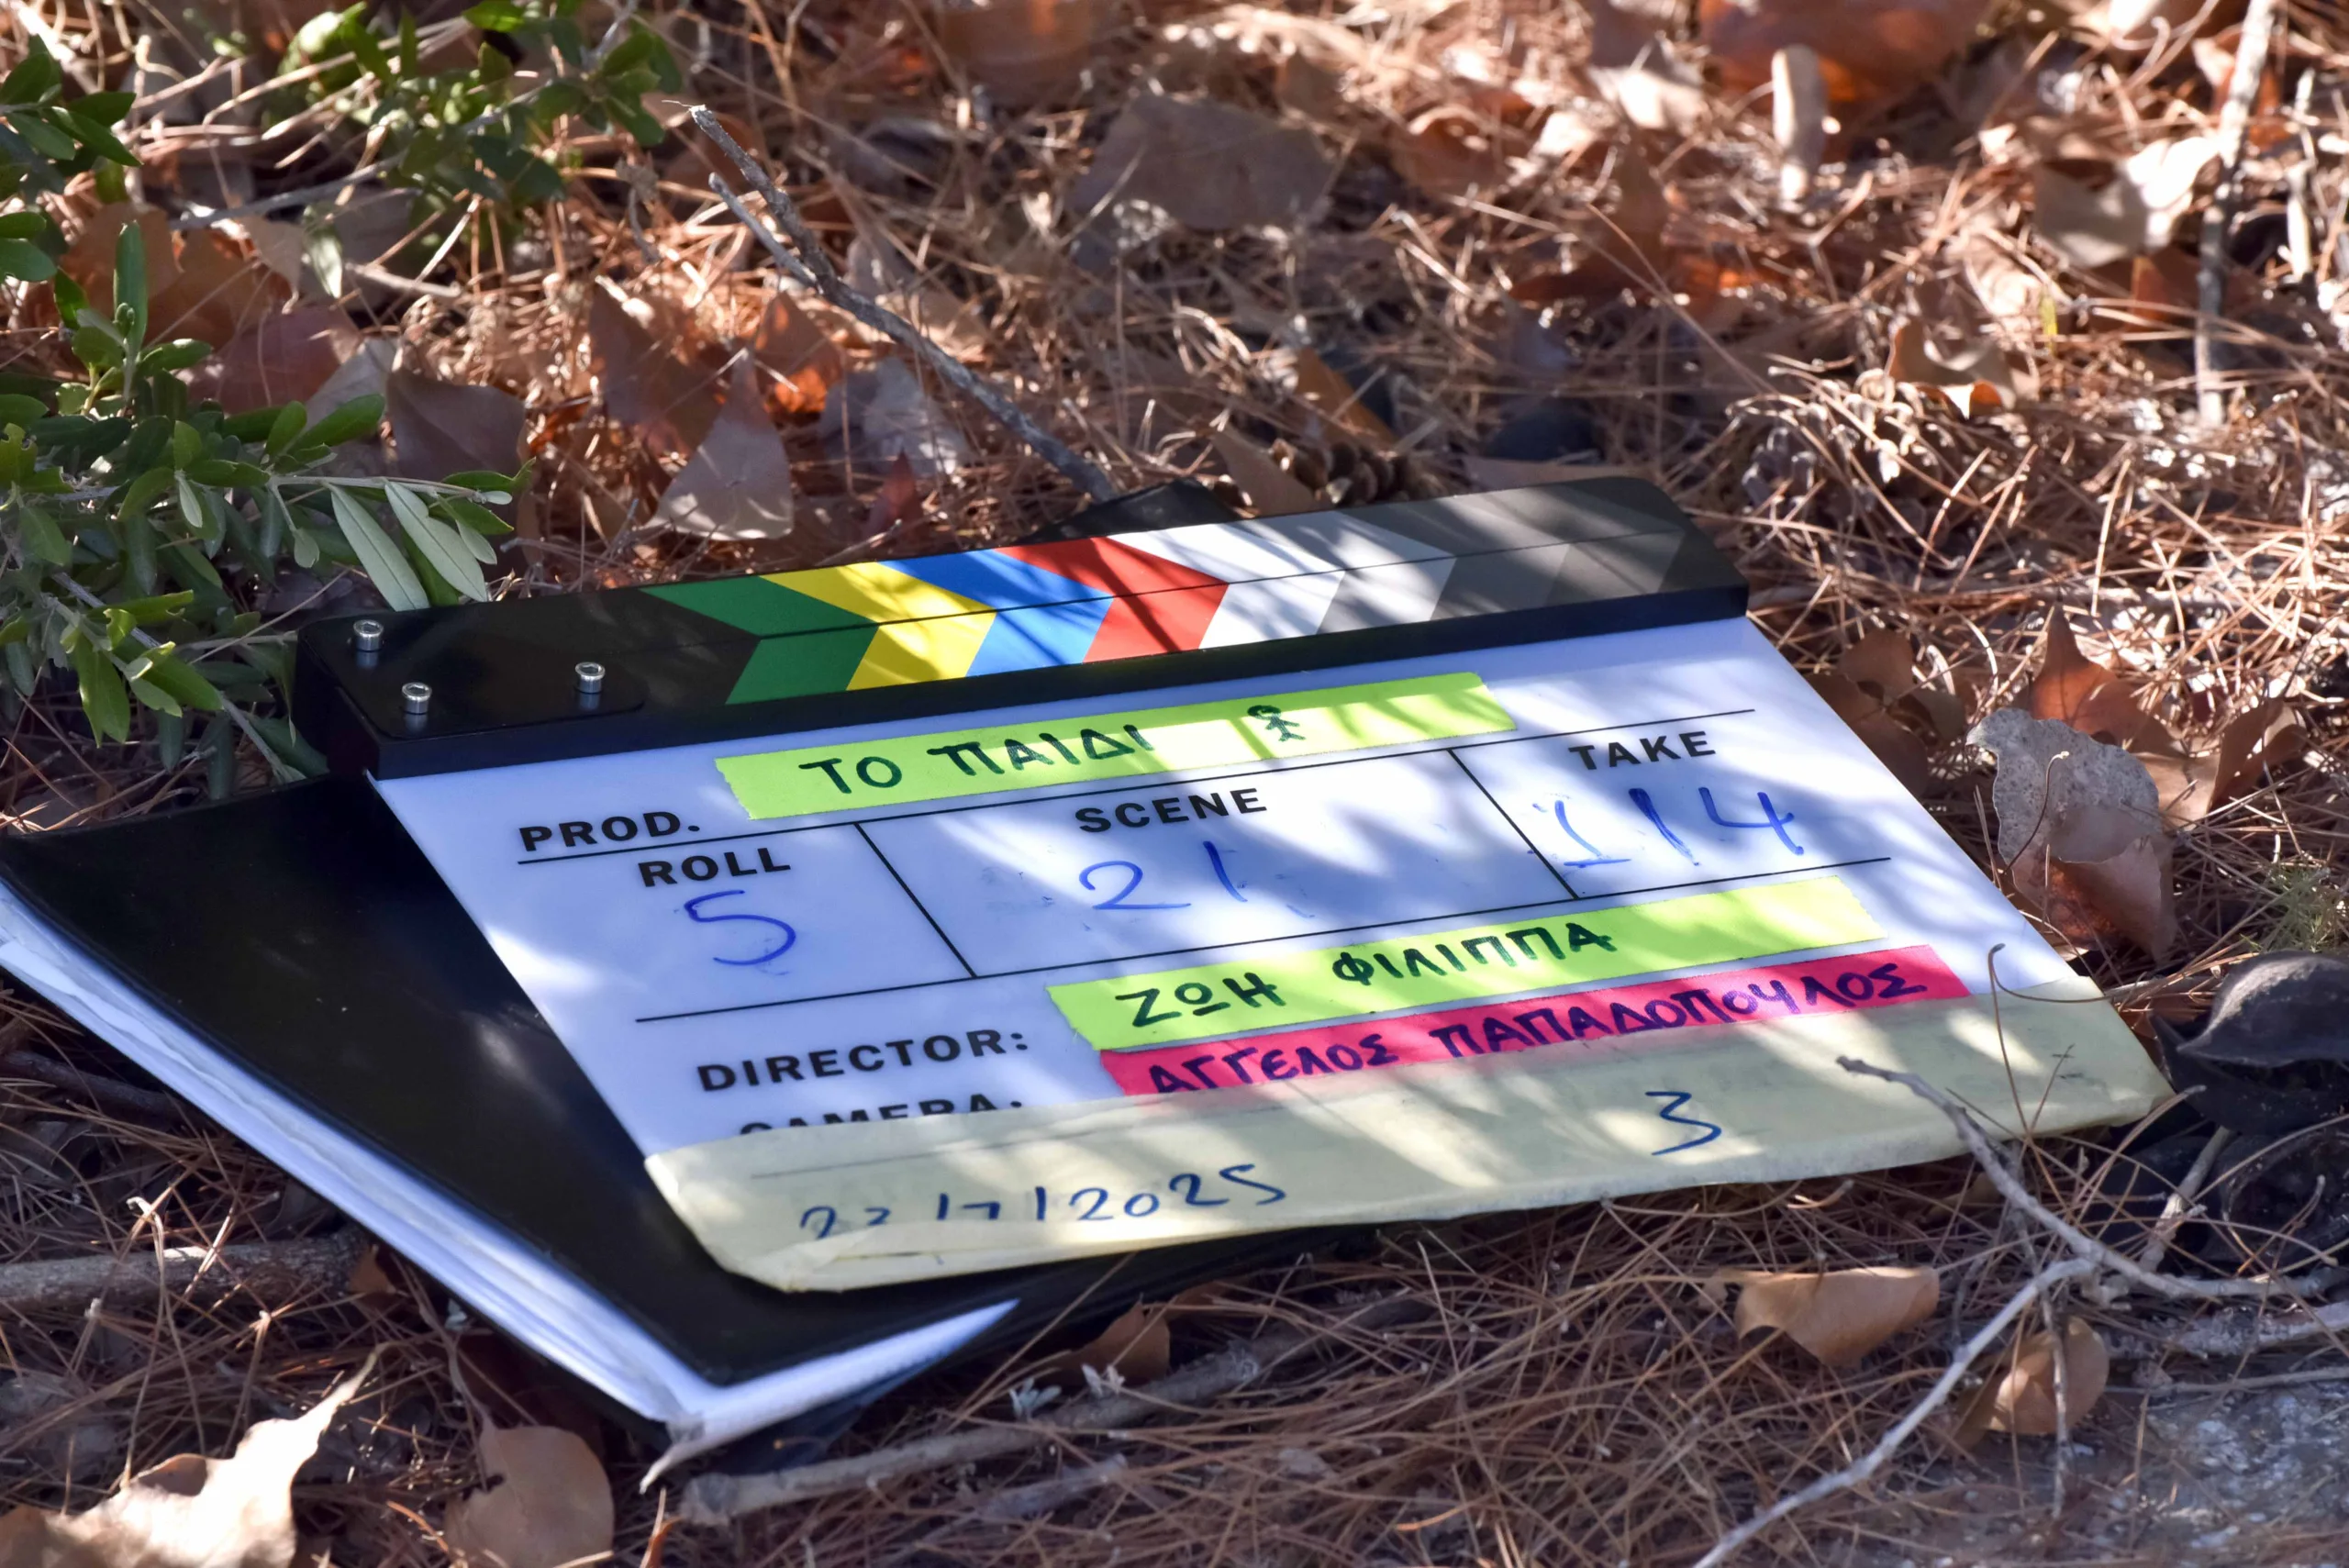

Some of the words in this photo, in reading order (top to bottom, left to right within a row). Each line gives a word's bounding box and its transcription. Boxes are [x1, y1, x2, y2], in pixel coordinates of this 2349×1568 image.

[927, 724, 1153, 776] ΠΑΙΔΙ
[1567, 730, 1716, 770] TAKE
[519, 811, 700, 852] PROD.
[1074, 788, 1267, 833] SCENE
[638, 847, 791, 887] ROLL
[1115, 973, 1287, 1028] ΖΩΗ
[1331, 922, 1618, 985] ΦΙΛΙΠΠΑ
[697, 1029, 1029, 1092] DIRECTOR:
[1149, 1033, 1400, 1094] ΑΓΓΕΛΟΣ
[1645, 1090, 1722, 1157] 3
